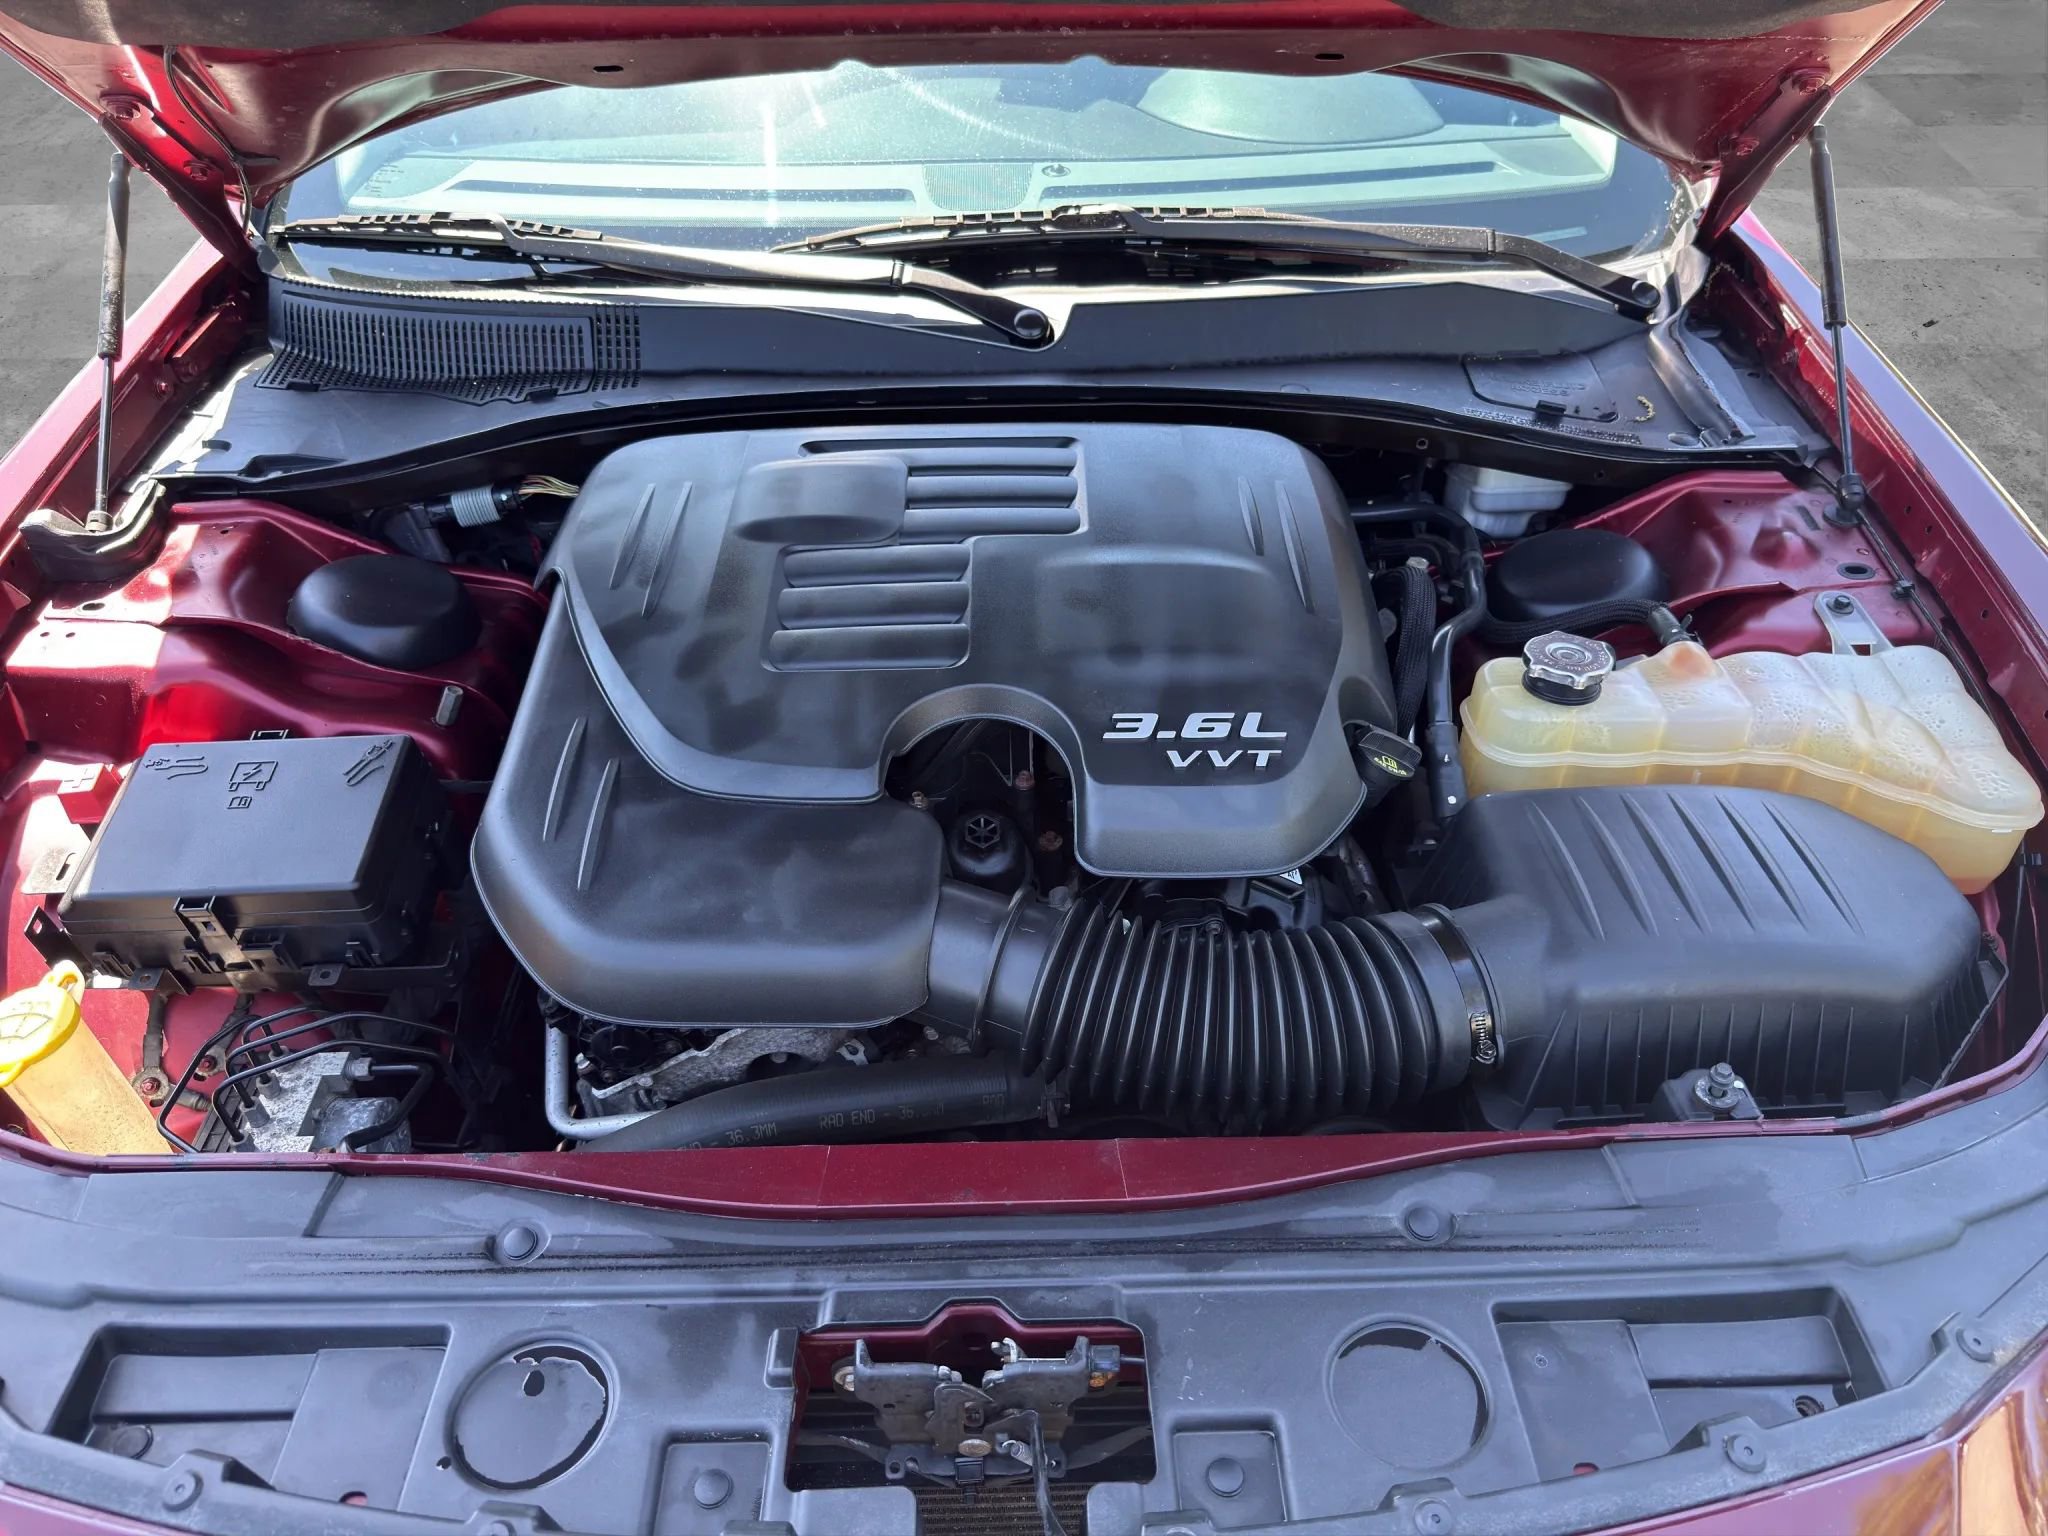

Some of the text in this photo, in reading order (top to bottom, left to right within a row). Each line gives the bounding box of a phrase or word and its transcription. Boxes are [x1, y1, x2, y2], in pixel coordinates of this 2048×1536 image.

[1102, 712, 1287, 740] 3.6L
[1165, 750, 1282, 768] VVT
[725, 1122, 778, 1145] 36.3MM
[819, 1112, 845, 1129] RAD
[851, 1109, 876, 1126] END
